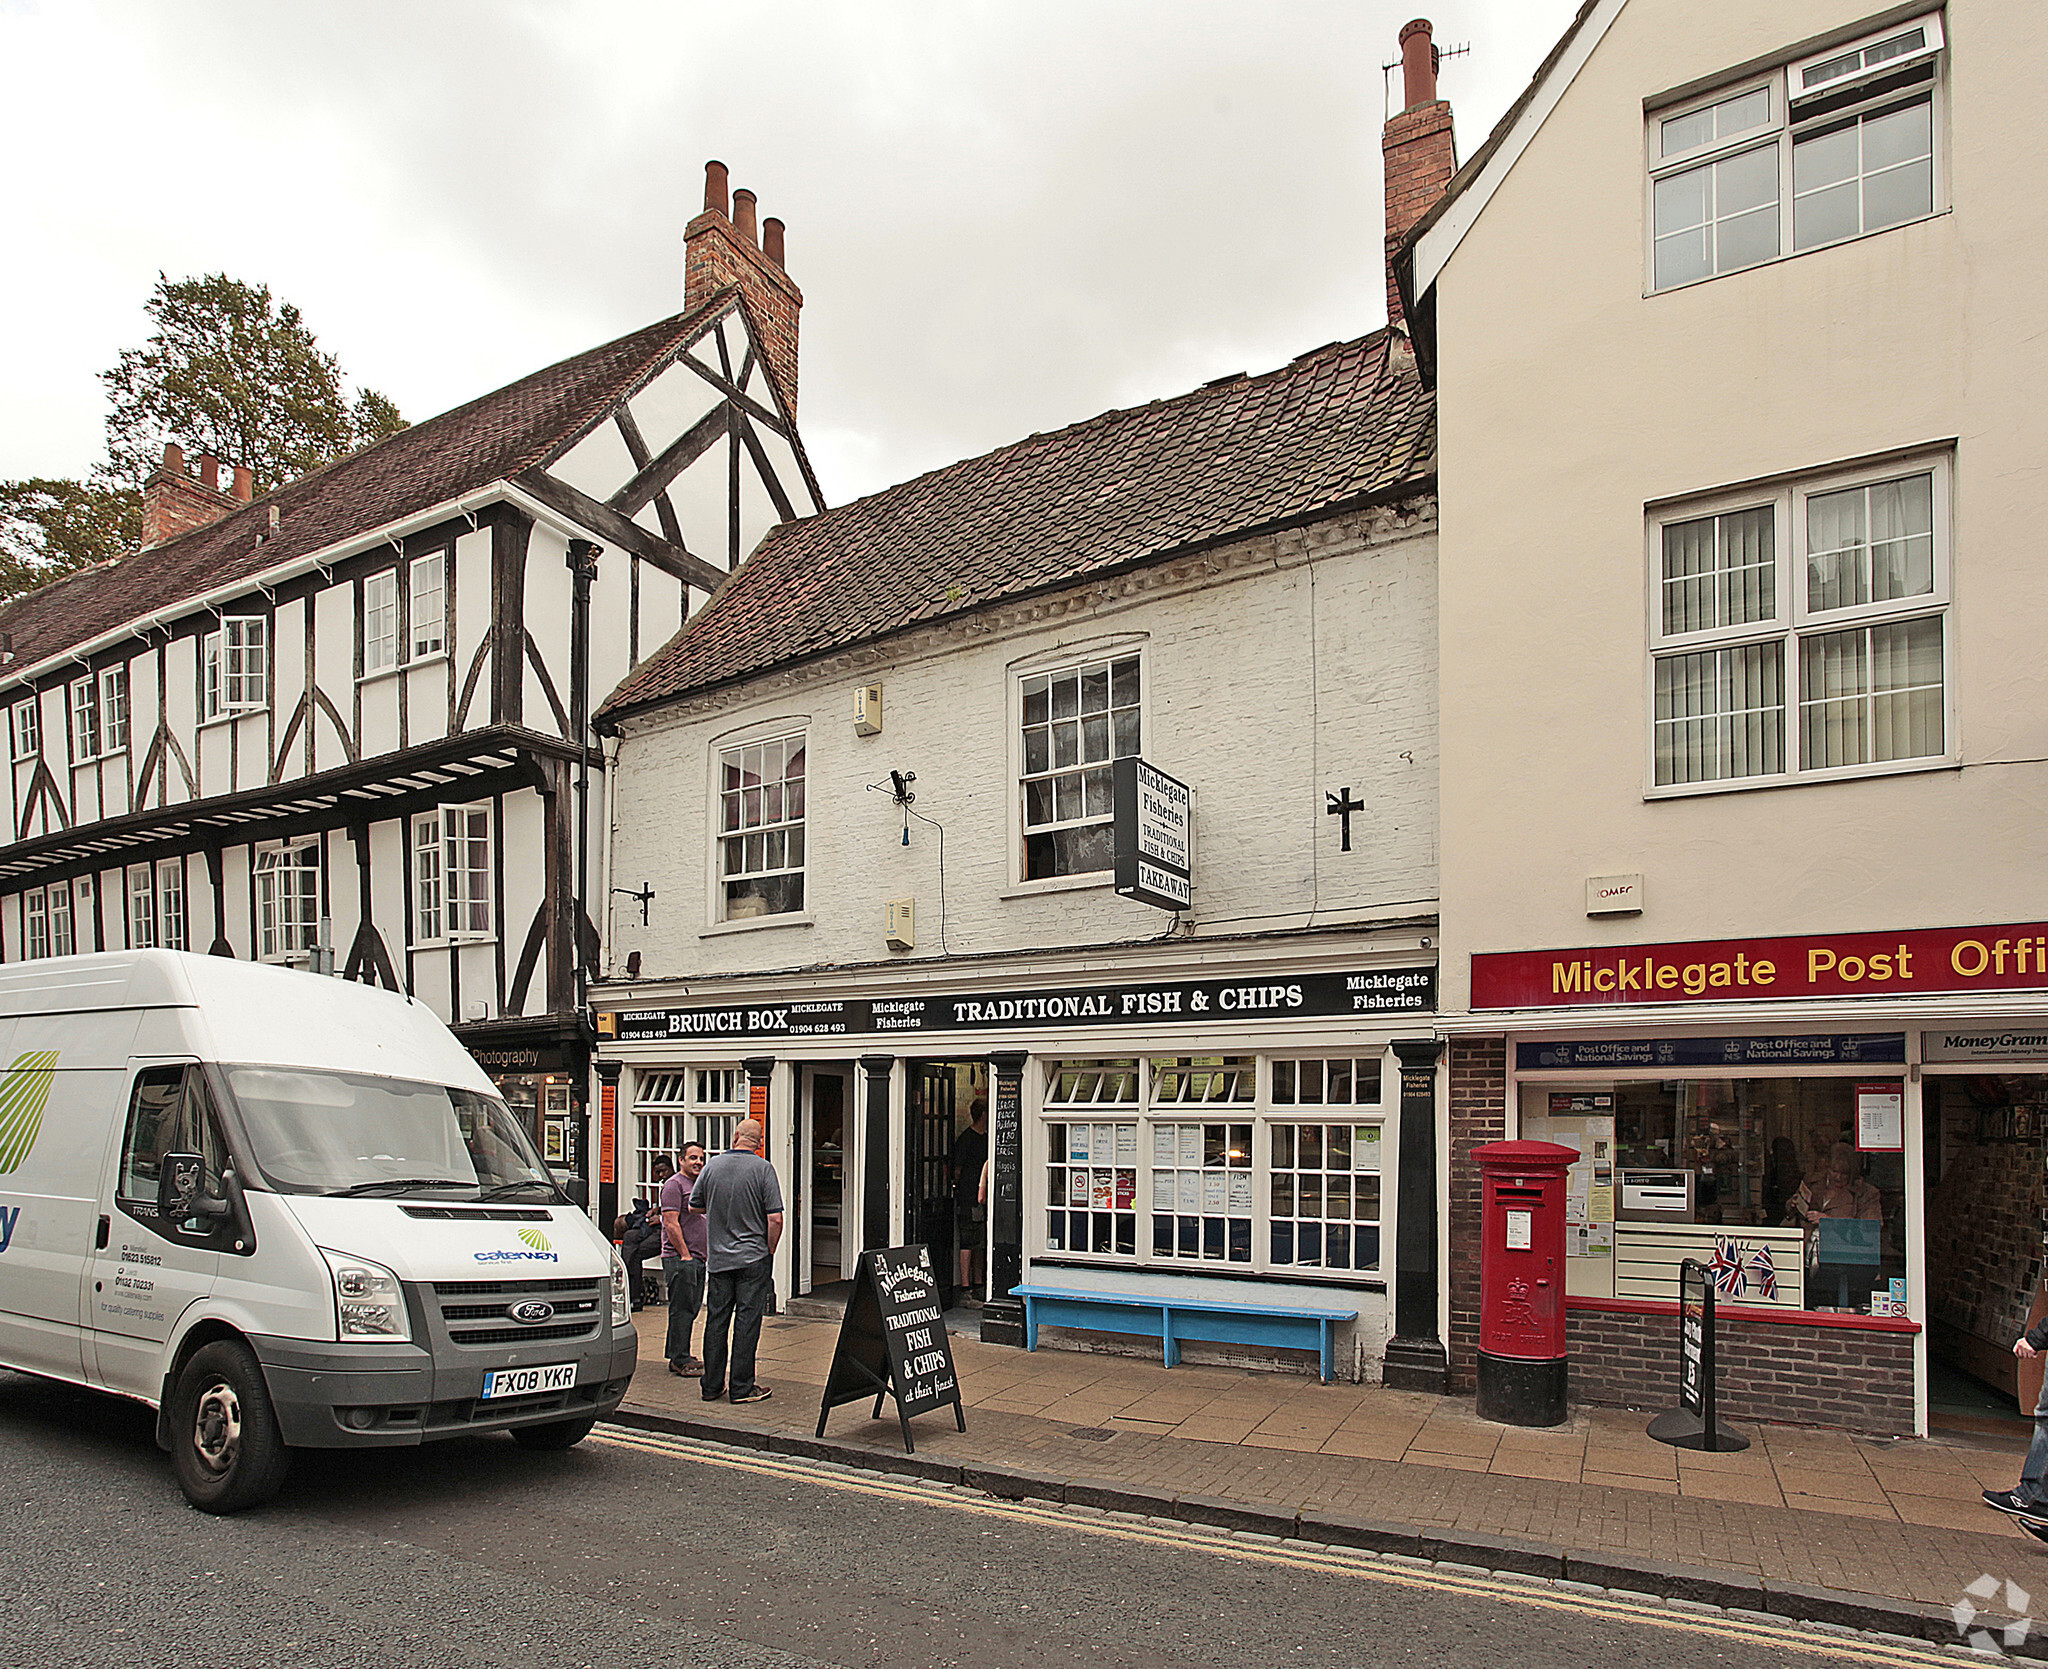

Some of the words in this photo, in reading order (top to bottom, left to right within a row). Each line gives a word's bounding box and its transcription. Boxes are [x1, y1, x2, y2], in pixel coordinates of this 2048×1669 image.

[1138, 765, 1186, 806] Micklegate
[1143, 791, 1184, 827] Fisheries
[1142, 824, 1185, 852] TRADITIONAL
[1143, 839, 1159, 857] FISH
[1160, 846, 1166, 859] &
[1166, 849, 1185, 867] CHIPS
[1139, 865, 1189, 899] TAKEAWAY
[1552, 953, 1776, 995] Micklegate
[1808, 944, 1913, 983] Post
[1950, 937, 2047, 977] Offi
[1346, 973, 1429, 991] Micklegate
[791, 1002, 843, 1014] MICKLEGATE
[872, 1001, 925, 1015] Micklegate
[953, 995, 1113, 1021] TRADITIONAL
[1121, 992, 1182, 1015] FISH
[1190, 990, 1210, 1011] &
[1218, 985, 1304, 1009] CHIPS
[1353, 994, 1422, 1009] Fisheries
[623, 1012, 666, 1021] MICKLEGATE
[669, 1011, 742, 1033] BRUNCH
[747, 1009, 789, 1030] BOX
[876, 1016, 921, 1029] Fisheries
[621, 1031, 641, 1039] 01904
[654, 1030, 667, 1038] 493
[789, 1025, 812, 1034] 01904
[813, 1024, 829, 1033] 628
[830, 1023, 846, 1032] 493
[1578, 1045, 1599, 1054] Post
[1600, 1044, 1629, 1053] Office
[1630, 1043, 1650, 1052] and
[1749, 1041, 1774, 1050] Post
[1775, 1040, 1808, 1049] Office
[1810, 1039, 1832, 1048] and
[1943, 1034, 2048, 1049] MoneyGram
[473, 1048, 539, 1067] Photography
[1575, 1053, 1615, 1062] National
[1616, 1052, 1653, 1062] Savings
[1746, 1049, 1791, 1058] National
[1793, 1048, 1835, 1059] Savings
[998, 1111, 1016, 1120] BLACK
[121, 1252, 139, 1263] 01623
[140, 1254, 162, 1266] 515812
[473, 1250, 559, 1263] caterway
[132, 1279, 155, 1292] 702331
[879, 1262, 934, 1297] Micklegate
[893, 1287, 927, 1304] Fisheries
[523, 1304, 547, 1317] Ford
[886, 1306, 941, 1331] TRADITIONAL
[905, 1328, 933, 1352] FISH
[903, 1360, 914, 1380] &
[914, 1350, 946, 1376] CHIPS
[493, 1371, 538, 1394] FX08
[543, 1367, 574, 1387] YKR
[905, 1388, 914, 1403] at
[915, 1380, 933, 1399] their
[934, 1375, 955, 1399] finest
